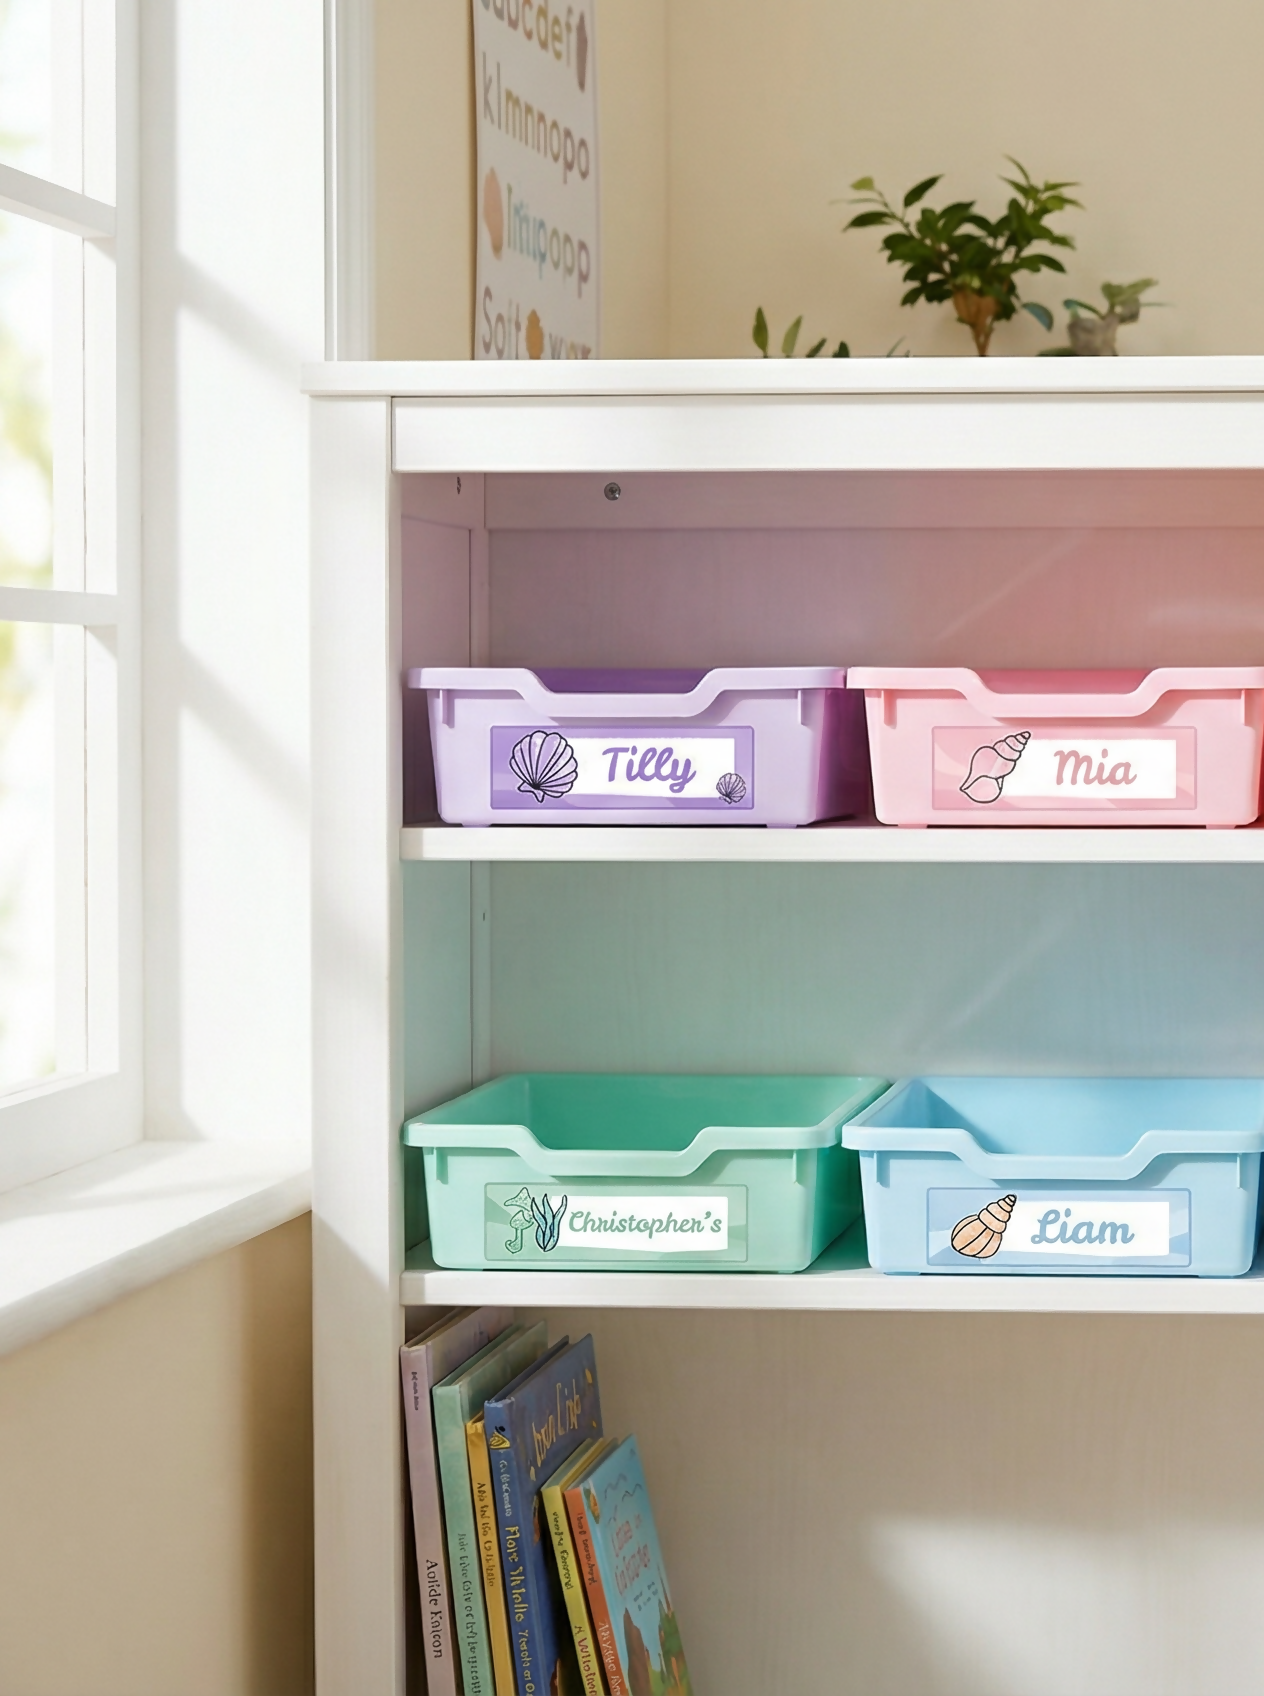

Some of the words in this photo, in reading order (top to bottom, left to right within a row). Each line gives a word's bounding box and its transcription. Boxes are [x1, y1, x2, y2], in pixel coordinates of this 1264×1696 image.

[602, 745, 696, 793] Tilly
[1053, 749, 1137, 785] Mia
[569, 1211, 722, 1239] Christopher's
[1031, 1208, 1134, 1244] Liam
